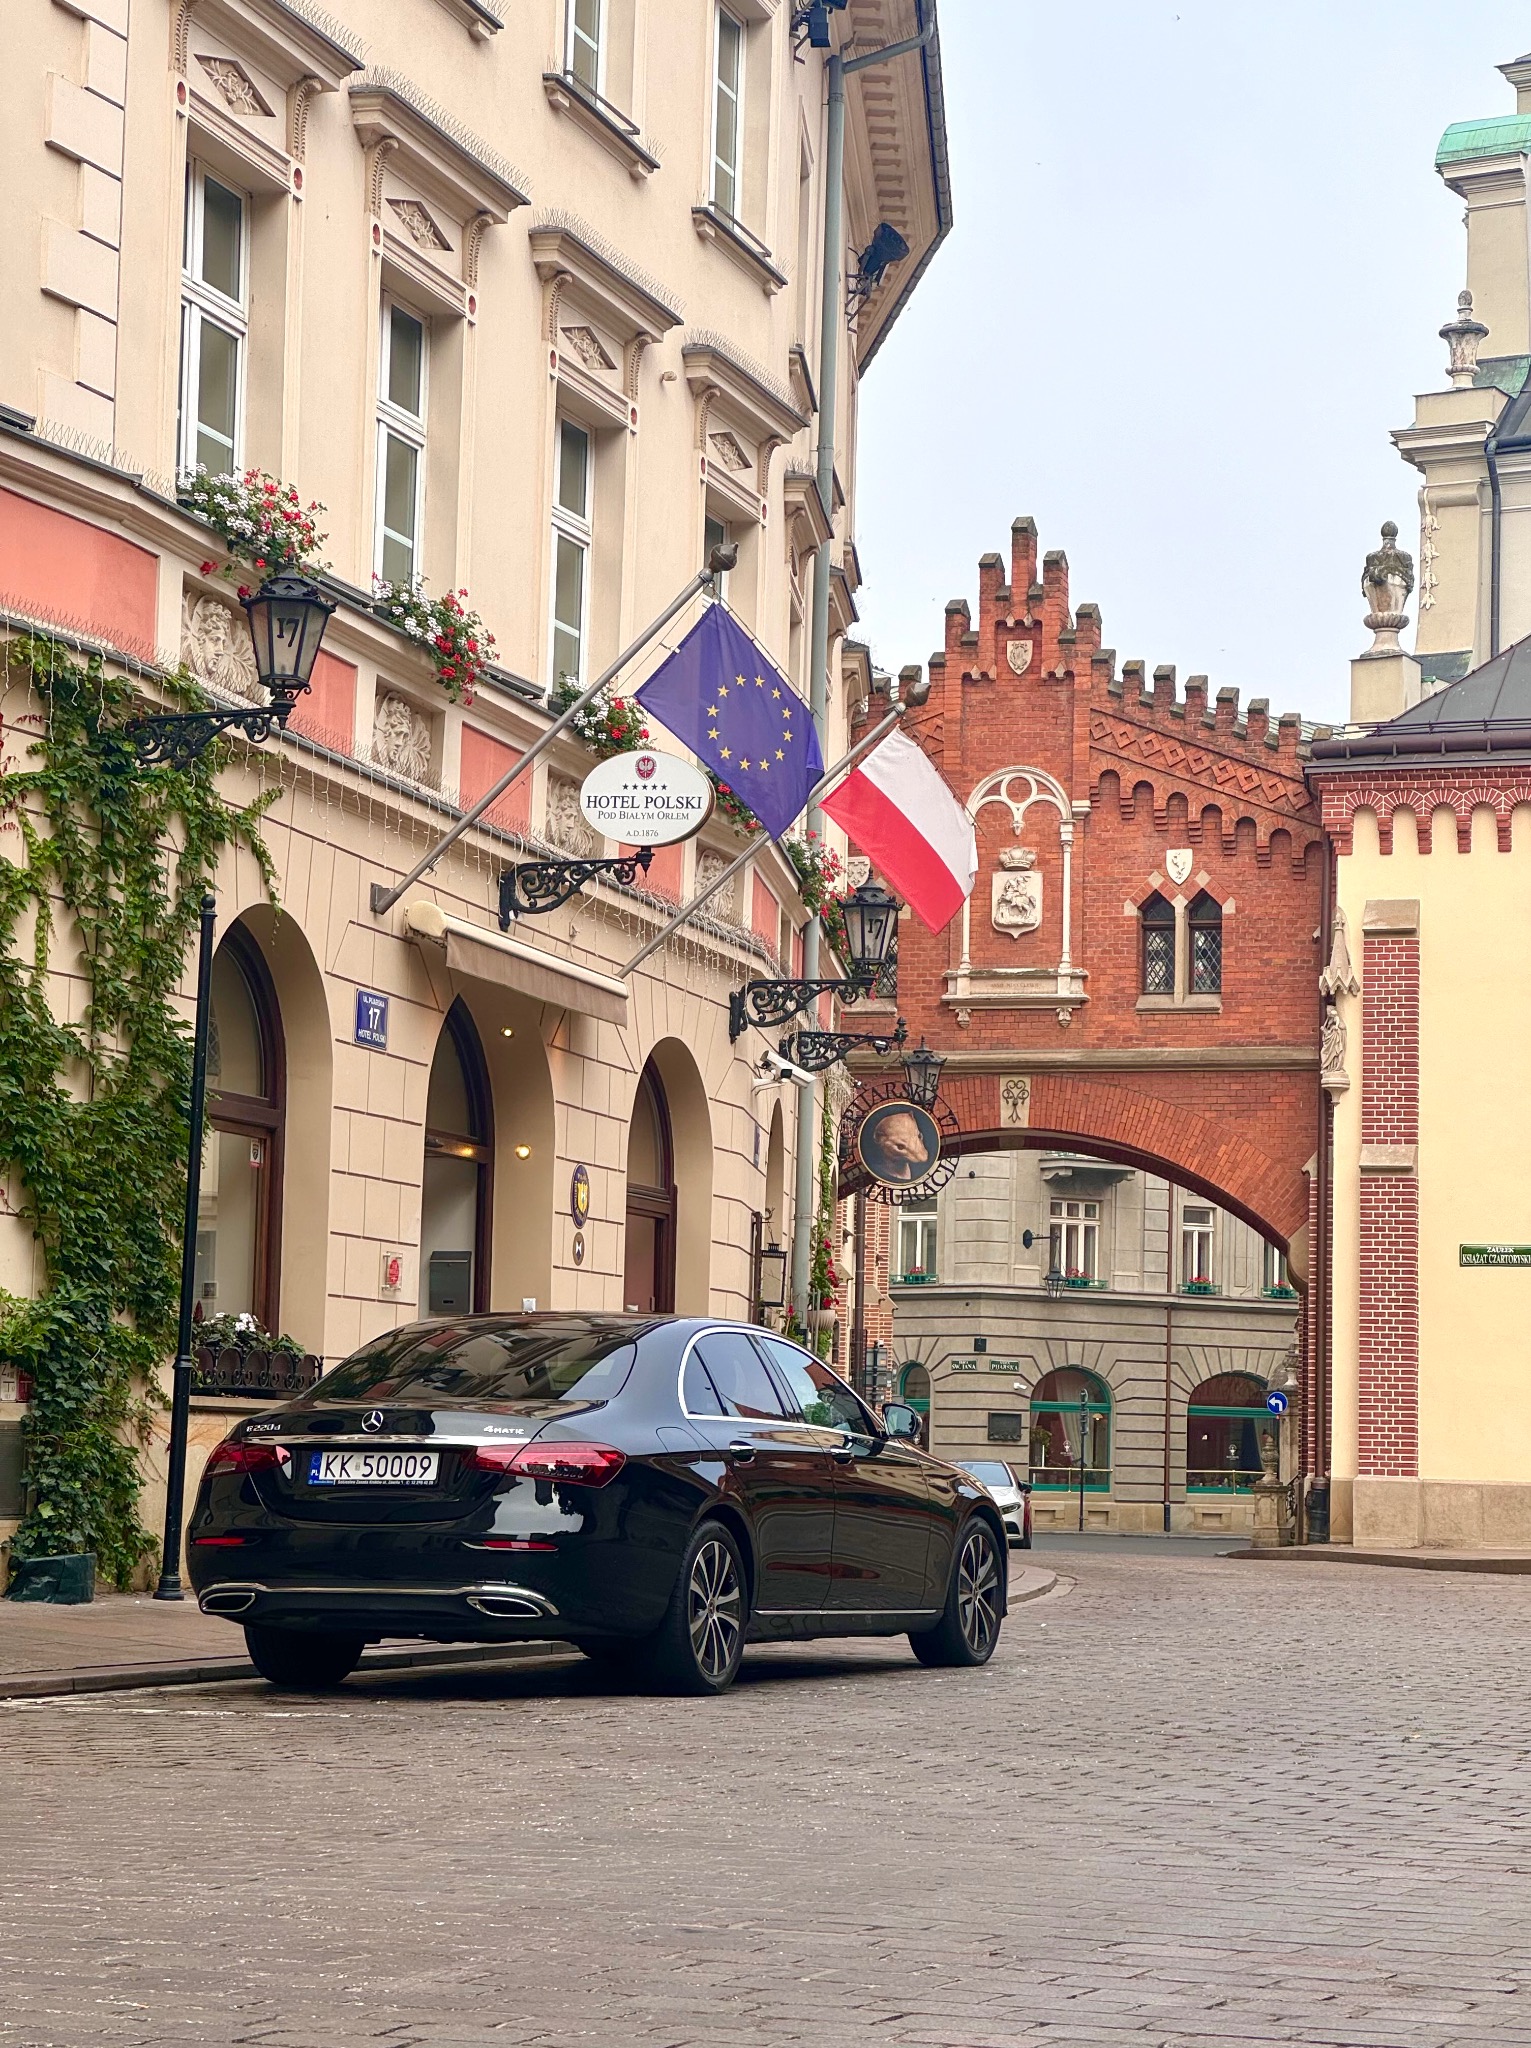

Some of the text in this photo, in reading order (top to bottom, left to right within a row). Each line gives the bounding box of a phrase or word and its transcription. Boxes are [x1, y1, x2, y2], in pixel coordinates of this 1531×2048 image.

[276, 617, 300, 648] 17
[586, 795, 703, 809] HOTEL POLSKI
[868, 919, 884, 940] 17
[368, 1007, 380, 1030] 17
[358, 1029, 386, 1043] HOTEL POLSKI
[928, 1072, 937, 1087] 17
[839, 1153, 960, 1206] RETAURACJA
[483, 1425, 525, 1435] 4MATIC
[310, 1469, 319, 1477] PL
[324, 1454, 432, 1478] KK 50009
